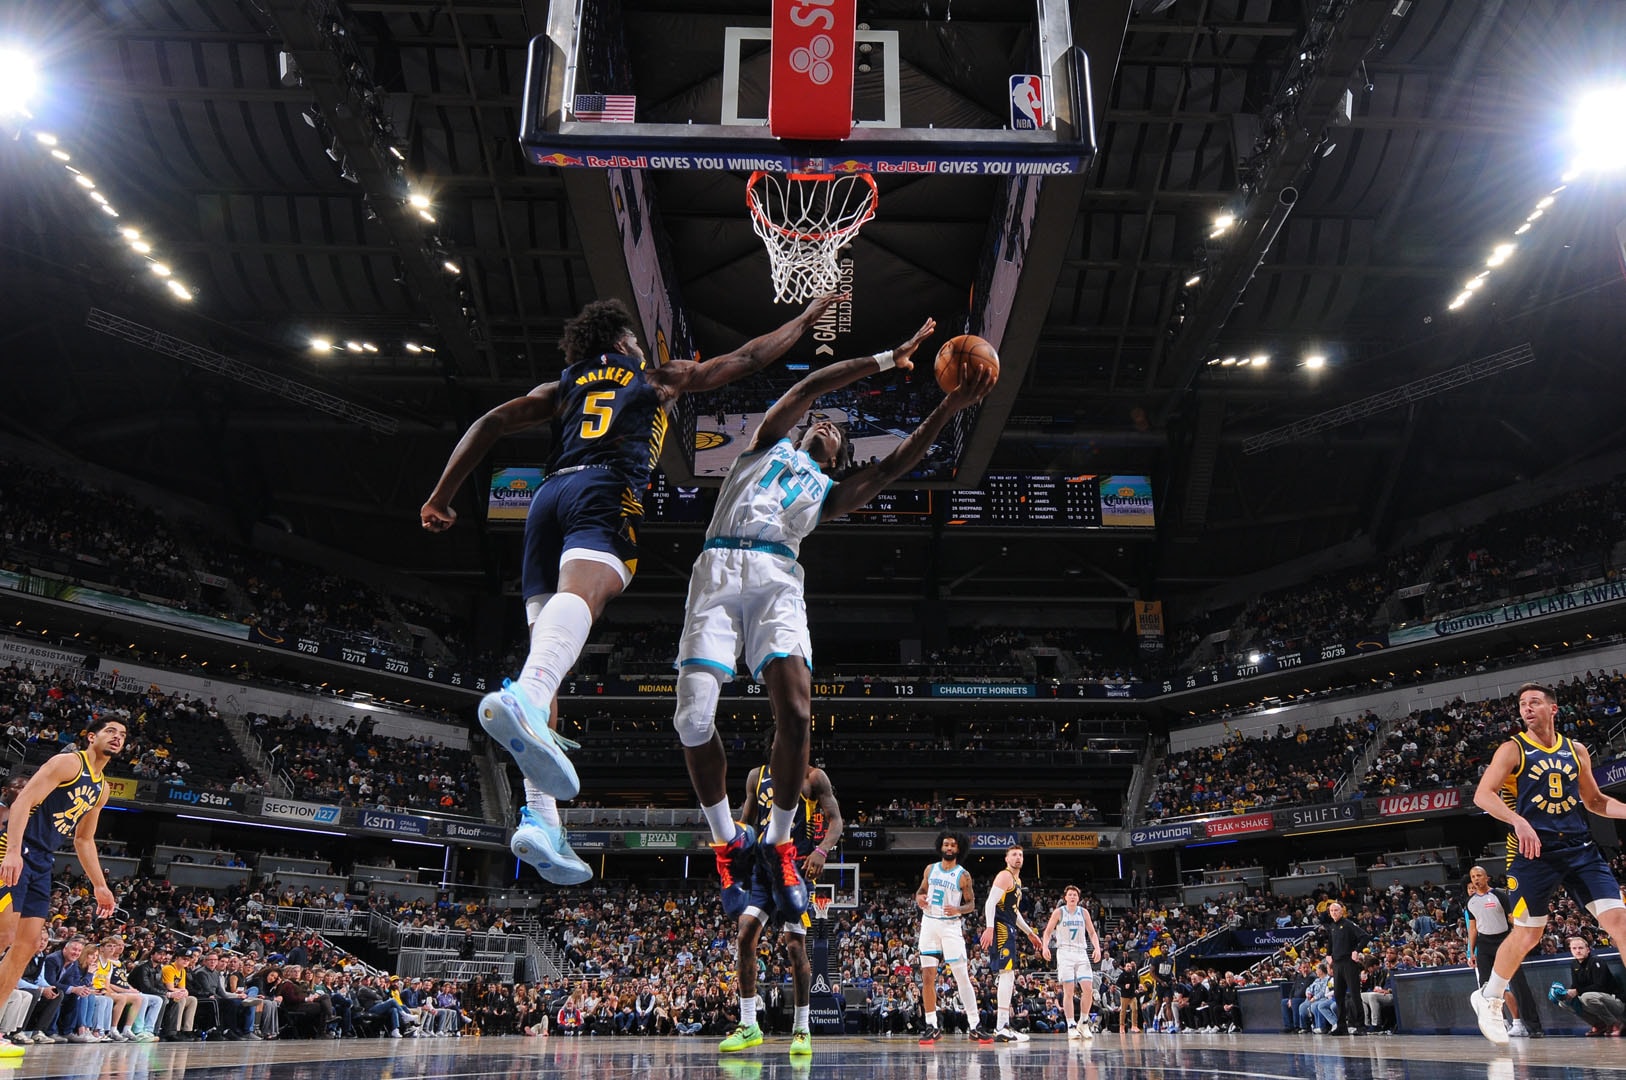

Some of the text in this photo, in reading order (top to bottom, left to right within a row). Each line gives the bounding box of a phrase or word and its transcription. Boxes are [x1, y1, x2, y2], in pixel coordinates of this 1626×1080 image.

[1016, 119, 1032, 129] NBA
[650, 157, 690, 169] GIVES
[694, 158, 725, 169] YOU
[939, 161, 978, 173] GIVES
[982, 162, 1012, 174] YOU
[575, 366, 634, 387] WALKER
[580, 391, 615, 439] 5
[757, 459, 803, 510] 14
[493, 487, 534, 501] Coron
[1103, 494, 1150, 508] Corona
[1434, 613, 1495, 636] Corona
[1503, 607, 1524, 621] LA
[1527, 594, 1577, 618] PLAYA
[3, 643, 27, 653] NEED
[297, 642, 319, 655] 9/30
[1321, 647, 1346, 660] 20/39
[341, 651, 366, 665] 12/14
[1278, 656, 1302, 669] 11/14
[385, 661, 409, 674] 32/70
[1237, 666, 1259, 677] 41/71
[428, 671, 433, 679] 6
[451, 676, 461, 685] 25
[476, 682, 486, 690] 26
[570, 686, 576, 694] 2
[638, 684, 673, 692] INDIANA
[747, 685, 761, 694] 85
[814, 684, 845, 695] 10:17
[1162, 684, 1172, 693] 39
[1186, 679, 1196, 688] 28
[894, 686, 914, 695] 113
[940, 686, 1028, 695] CHARLOTTE HORNETS
[1528, 758, 1578, 782] INDIANA
[1548, 772, 1563, 798] 9
[168, 788, 232, 806] IndyStar.
[1380, 791, 1459, 814] LUCAS OIL
[1531, 794, 1577, 814] PACERS
[264, 802, 335, 821] SECTION 127
[1293, 807, 1338, 824] SHIFT
[363, 812, 395, 830] ksm
[1208, 822, 1234, 833] STEAK
[1241, 818, 1269, 829] SHAKE
[458, 826, 480, 837] Ruoff
[648, 833, 676, 842] RYAN
[1148, 827, 1192, 840] HYUNDAI
[931, 889, 944, 906] 3
[1069, 929, 1078, 940] 7
[1254, 936, 1295, 944] CareSource
